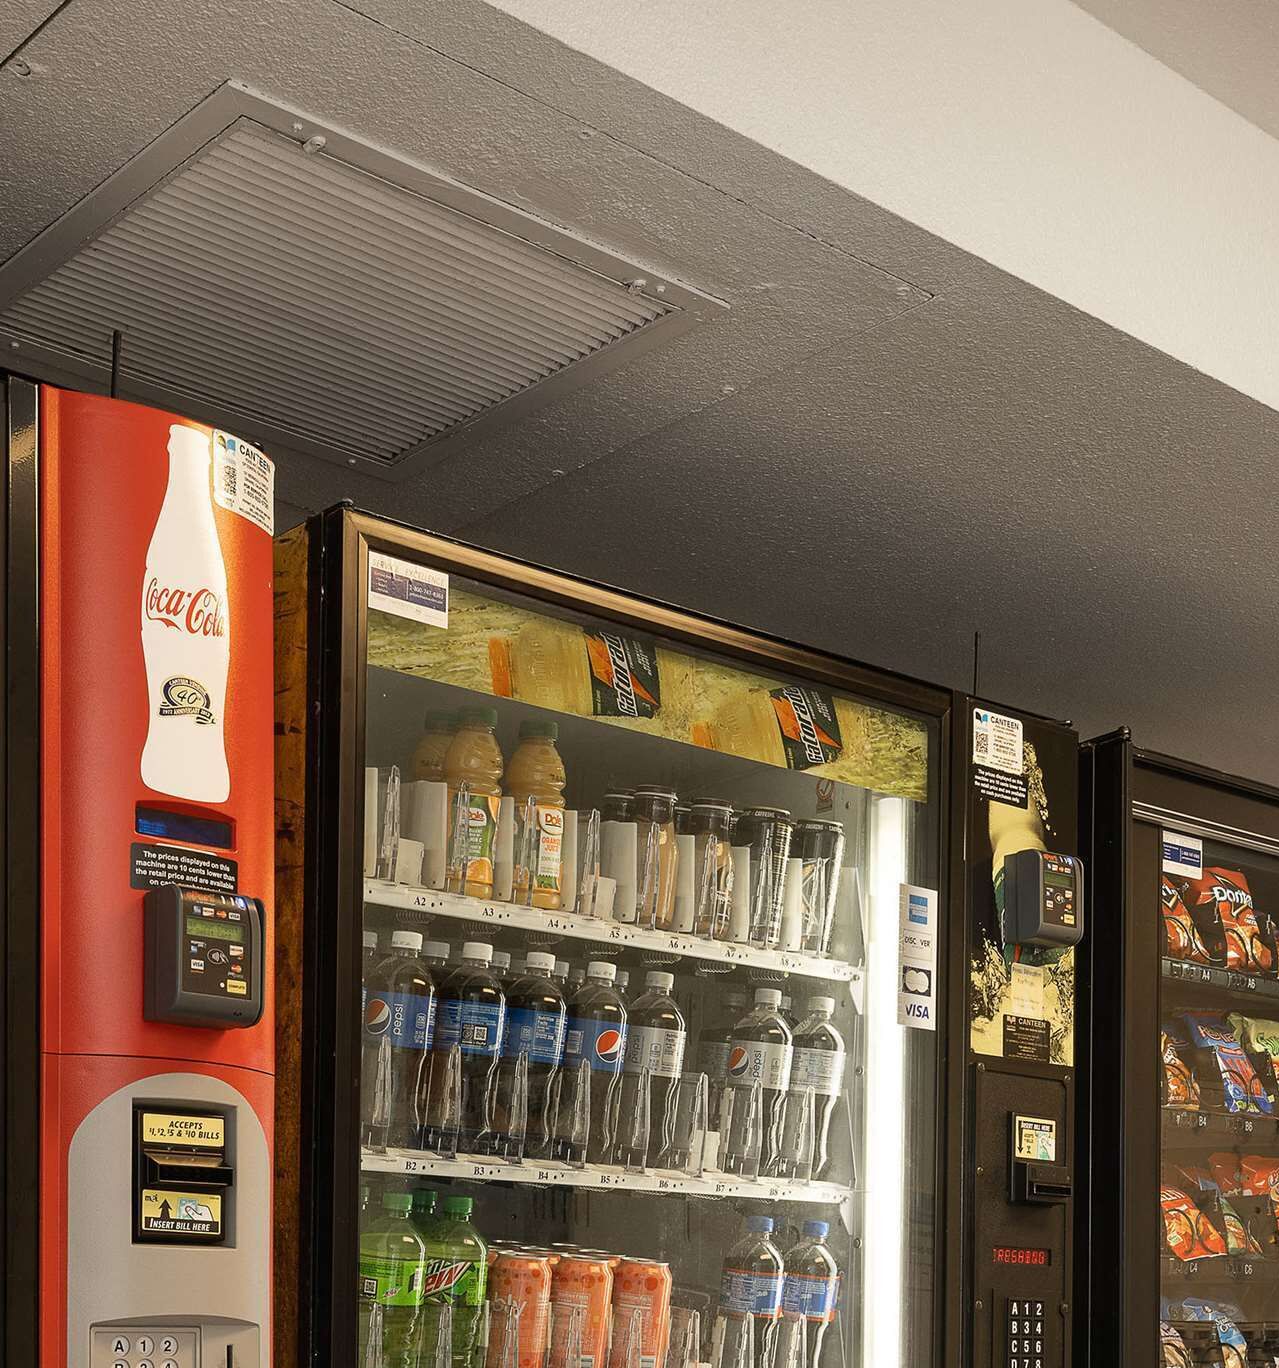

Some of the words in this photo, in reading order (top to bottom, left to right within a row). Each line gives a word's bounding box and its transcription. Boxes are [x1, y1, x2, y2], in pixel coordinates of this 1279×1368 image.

[145, 576, 225, 639] Coca-Cola
[784, 685, 826, 764] Gatorade
[990, 716, 1019, 730] CANTEEN
[143, 850, 157, 859] The
[157, 852, 179, 862] prices
[180, 856, 211, 868] displayed
[210, 862, 220, 870] on
[219, 863, 231, 872] this
[135, 859, 166, 870] machine
[179, 864, 188, 872] 10
[188, 866, 206, 875] cents
[206, 868, 223, 879] lower
[223, 873, 236, 882] than
[135, 867, 148, 876] the
[148, 869, 167, 878] retail
[167, 872, 185, 882] price
[185, 875, 198, 883] and
[198, 877, 209, 885] are
[209, 879, 234, 890] available
[413, 898, 426, 906] A2
[482, 908, 494, 917] A3
[547, 919, 559, 928] A4
[1201, 969, 1211, 980] A4
[1247, 978, 1256, 989] A6
[905, 1003, 930, 1020] VISA
[393, 1003, 404, 1037] pepsi
[1018, 1018, 1046, 1028] CANTEEN
[753, 1050, 763, 1083] pepsi
[168, 1120, 203, 1130] ACCEPTS
[1198, 1116, 1207, 1127] B4
[185, 1130, 196, 1138] $10
[198, 1130, 220, 1140] BILLS
[405, 1161, 417, 1170] B2
[473, 1167, 485, 1175] B3
[538, 1171, 549, 1180] B4
[600, 1176, 611, 1185] B5
[149, 1217, 174, 1229] INSERT
[175, 1221, 192, 1230] BILL
[192, 1223, 211, 1232] HERE
[1189, 1263, 1198, 1273] C4
[114, 1339, 125, 1353] A
[140, 1339, 147, 1353] 1
[163, 1339, 172, 1353] 2
